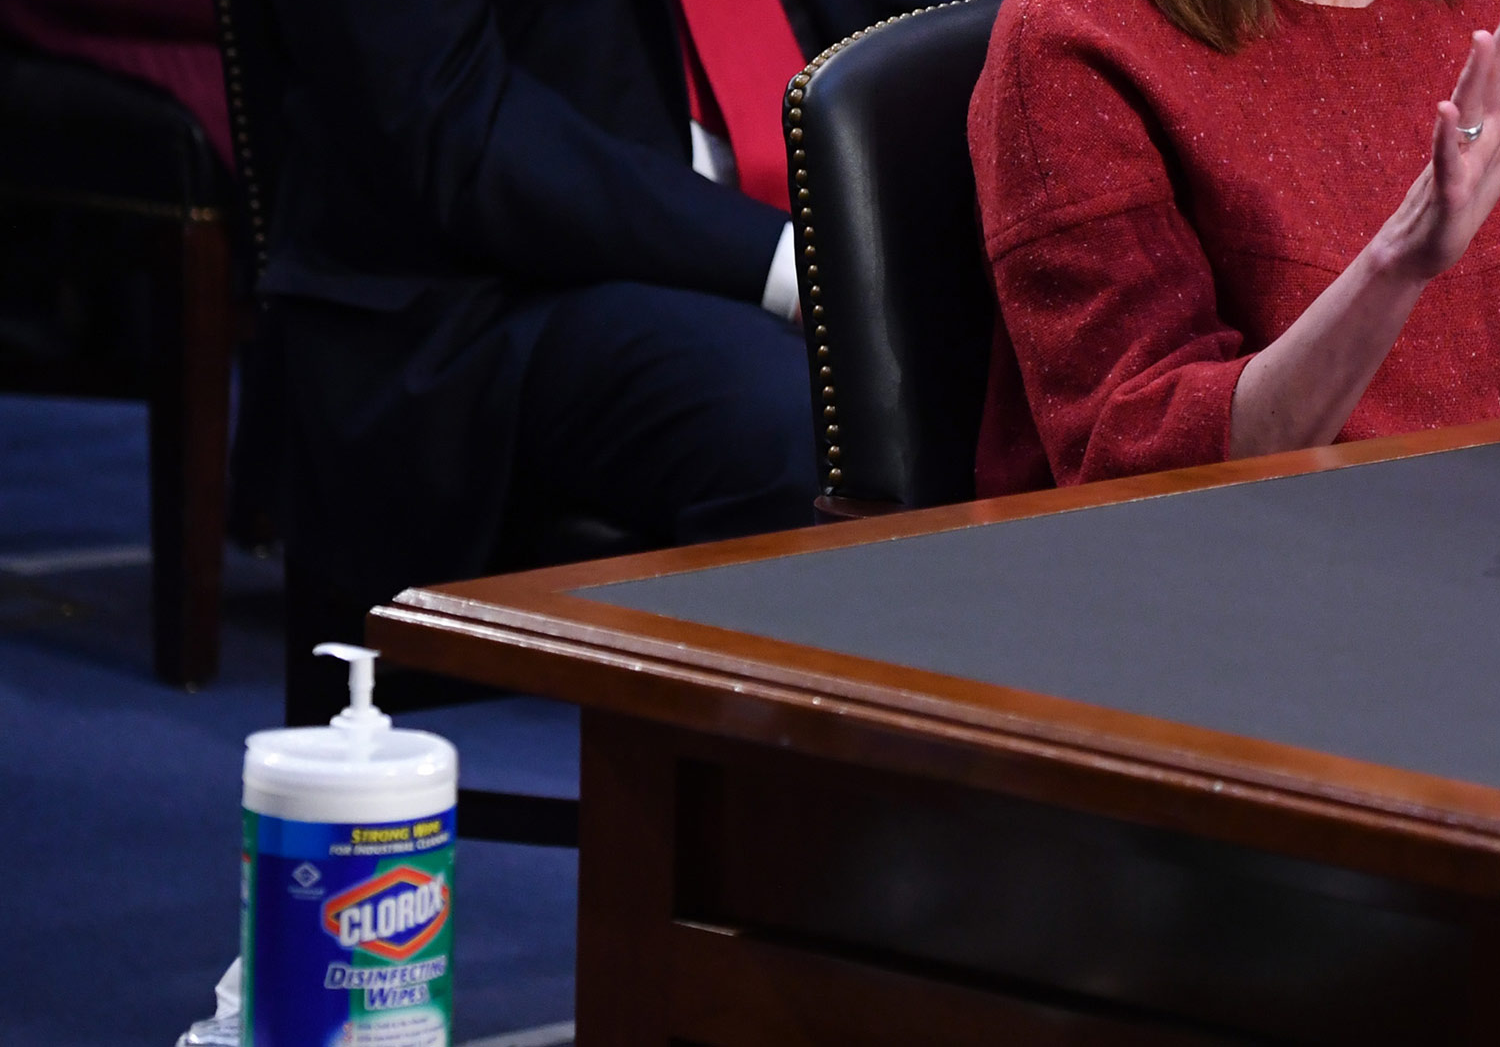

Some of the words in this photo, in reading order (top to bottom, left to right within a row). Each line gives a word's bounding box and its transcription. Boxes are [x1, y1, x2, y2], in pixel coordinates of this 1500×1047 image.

[351, 826, 410, 845] STRONG
[329, 844, 352, 856] FOR
[339, 875, 445, 947] CLOROX
[326, 957, 447, 987] DISINFECTING
[367, 987, 427, 1007] WIPES
